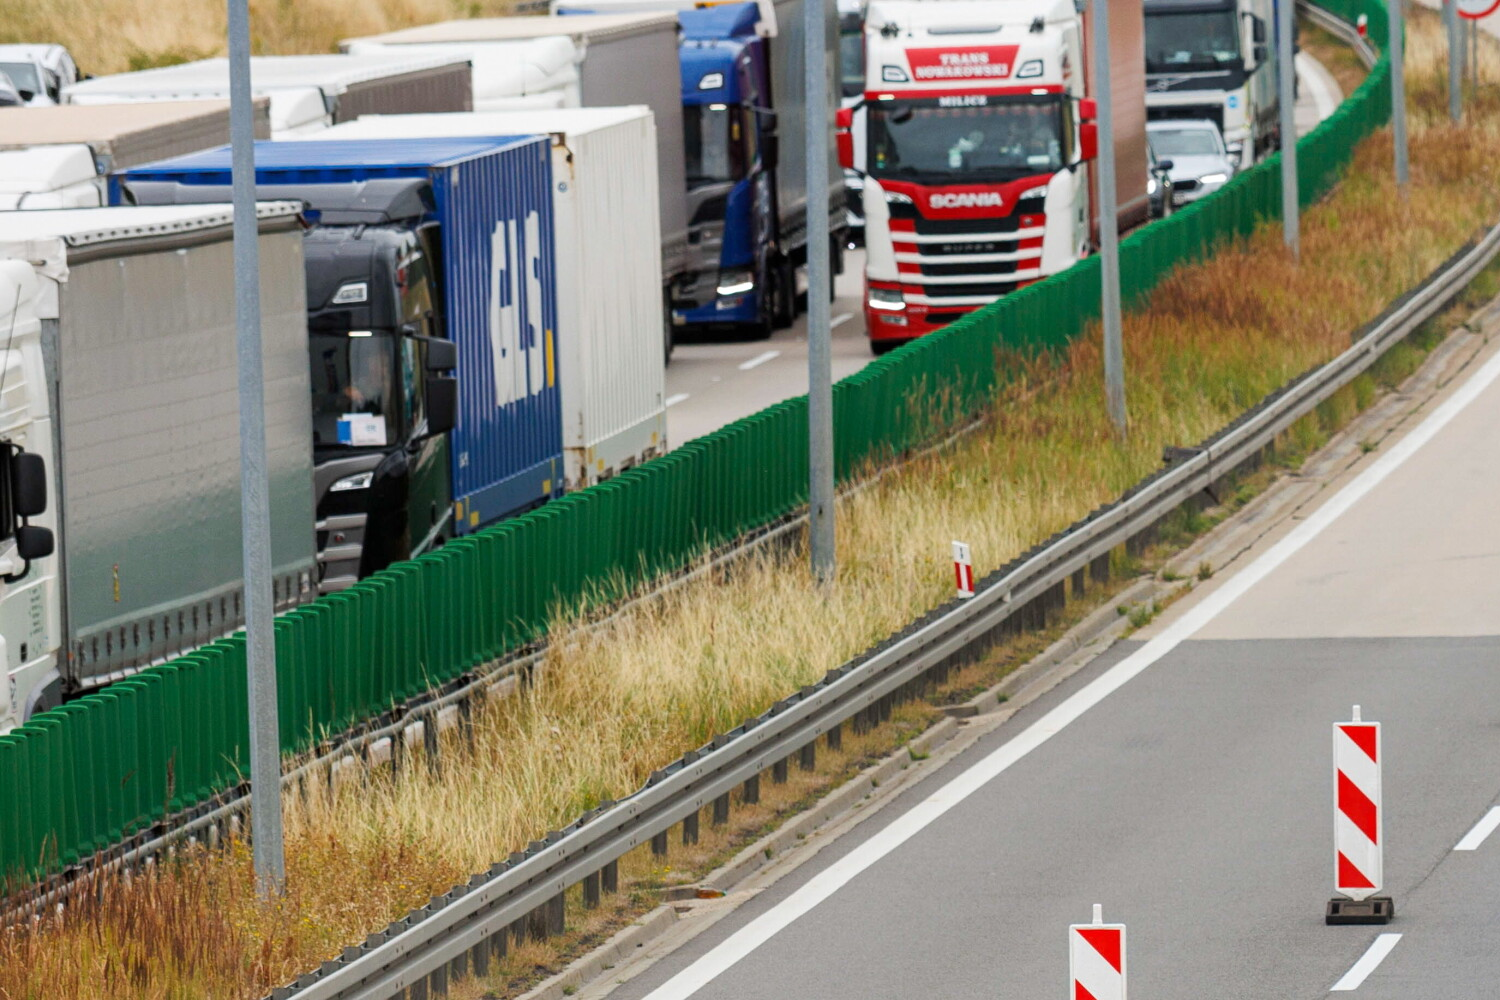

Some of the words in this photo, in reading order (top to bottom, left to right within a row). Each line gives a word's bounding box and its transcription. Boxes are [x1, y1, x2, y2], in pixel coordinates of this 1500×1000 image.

[938, 51, 990, 65] TRANS
[929, 191, 1004, 209] SCANIA
[490, 210, 544, 409] GLS
